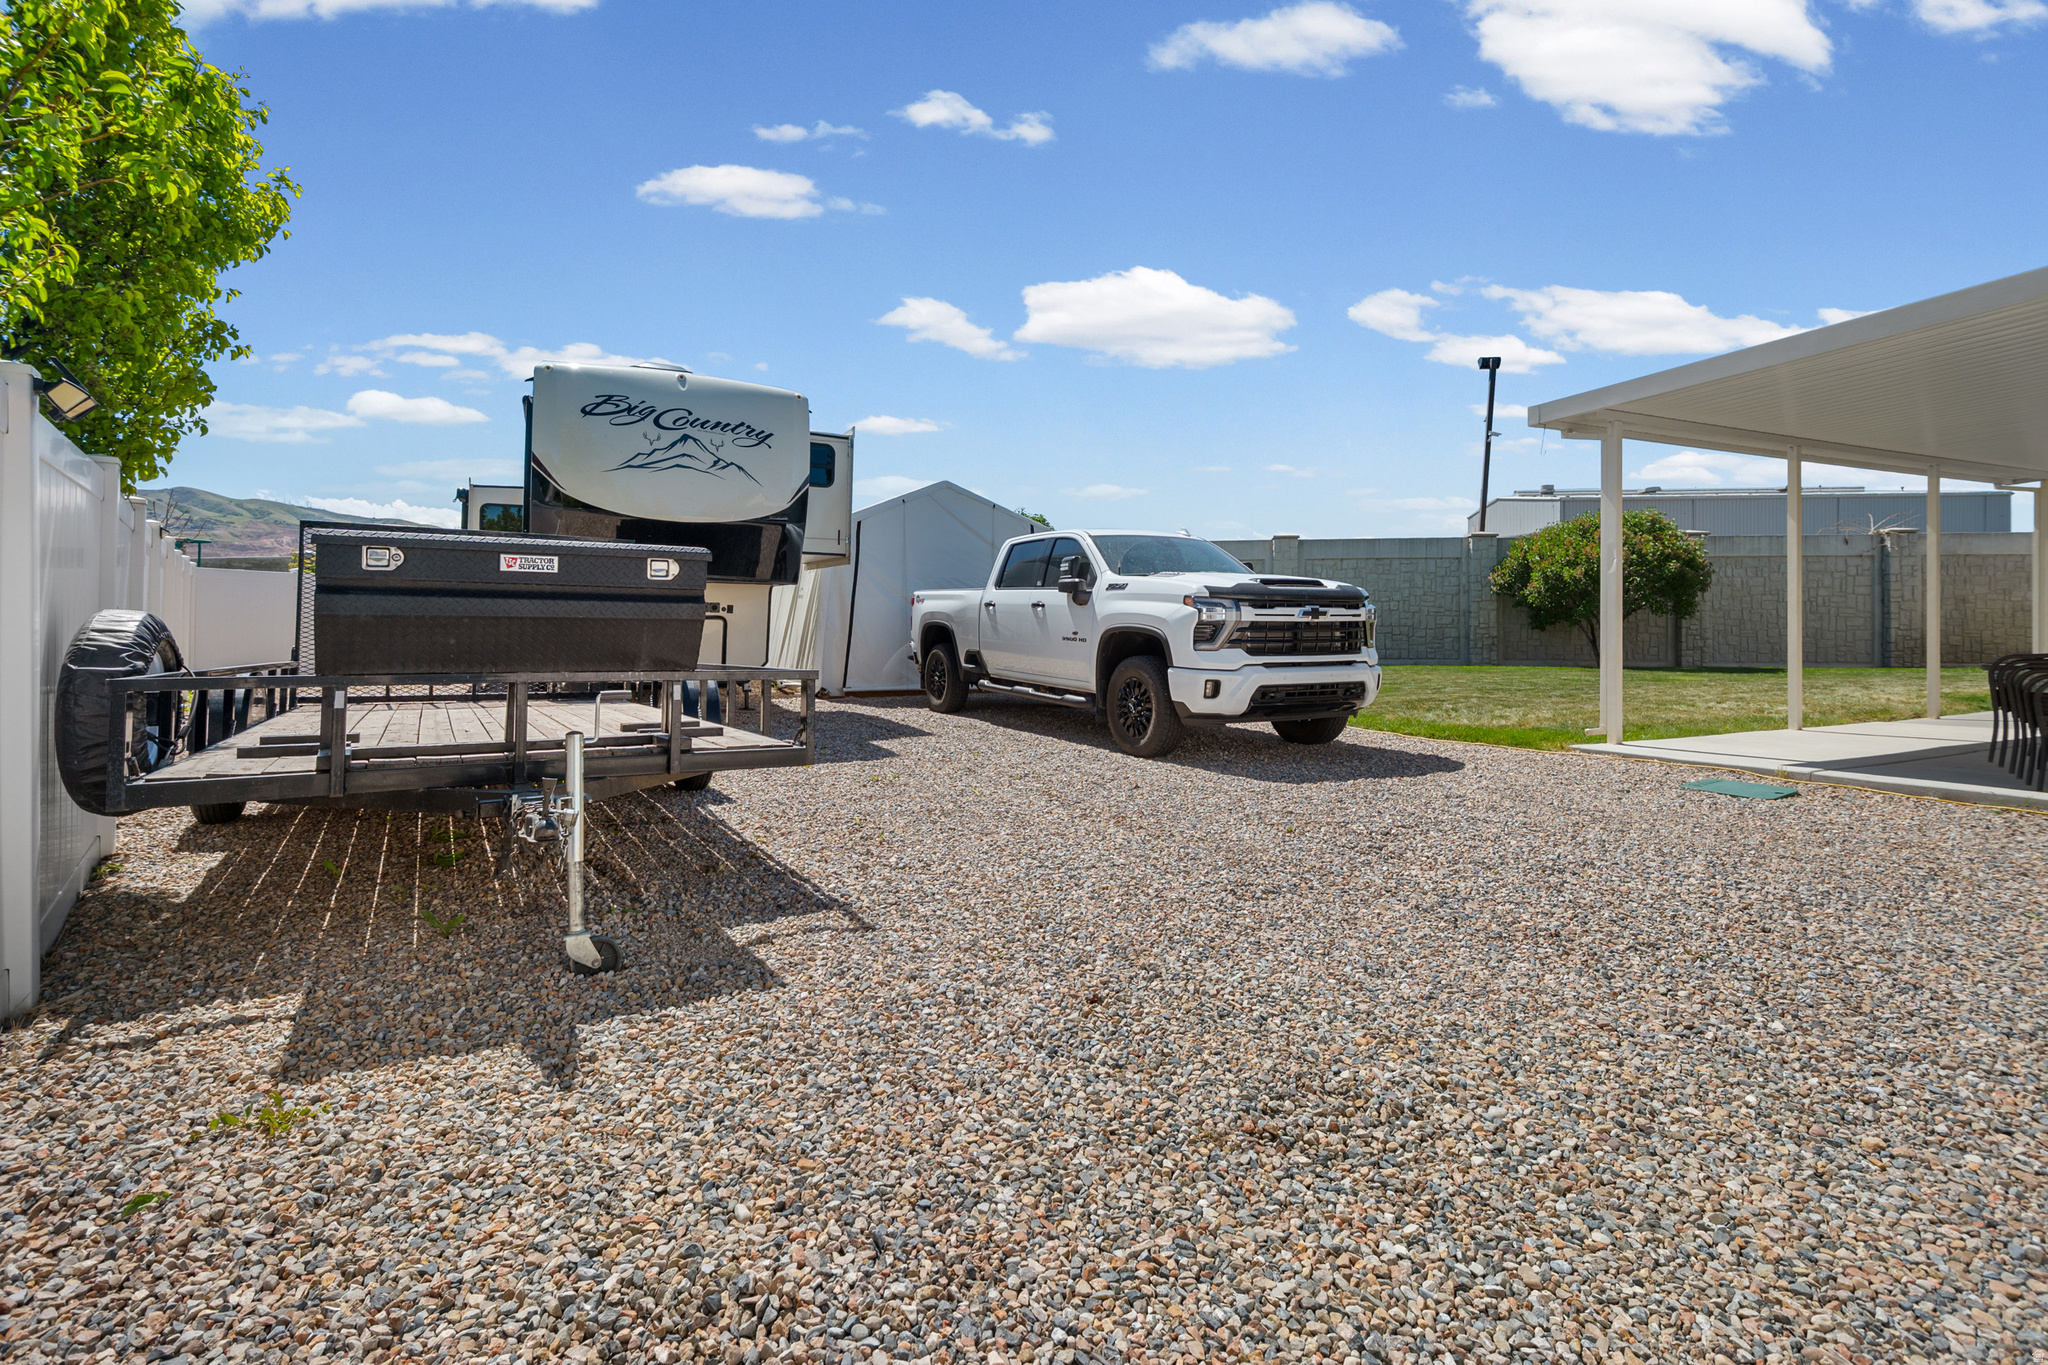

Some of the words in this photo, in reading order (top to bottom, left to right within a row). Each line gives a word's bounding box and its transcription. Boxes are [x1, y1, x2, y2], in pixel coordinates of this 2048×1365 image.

[580, 394, 657, 426] Big
[652, 408, 775, 449] Country
[504, 557, 517, 568] TSC
[518, 556, 555, 564] TRACTOR
[518, 563, 546, 571] SUPPLY
